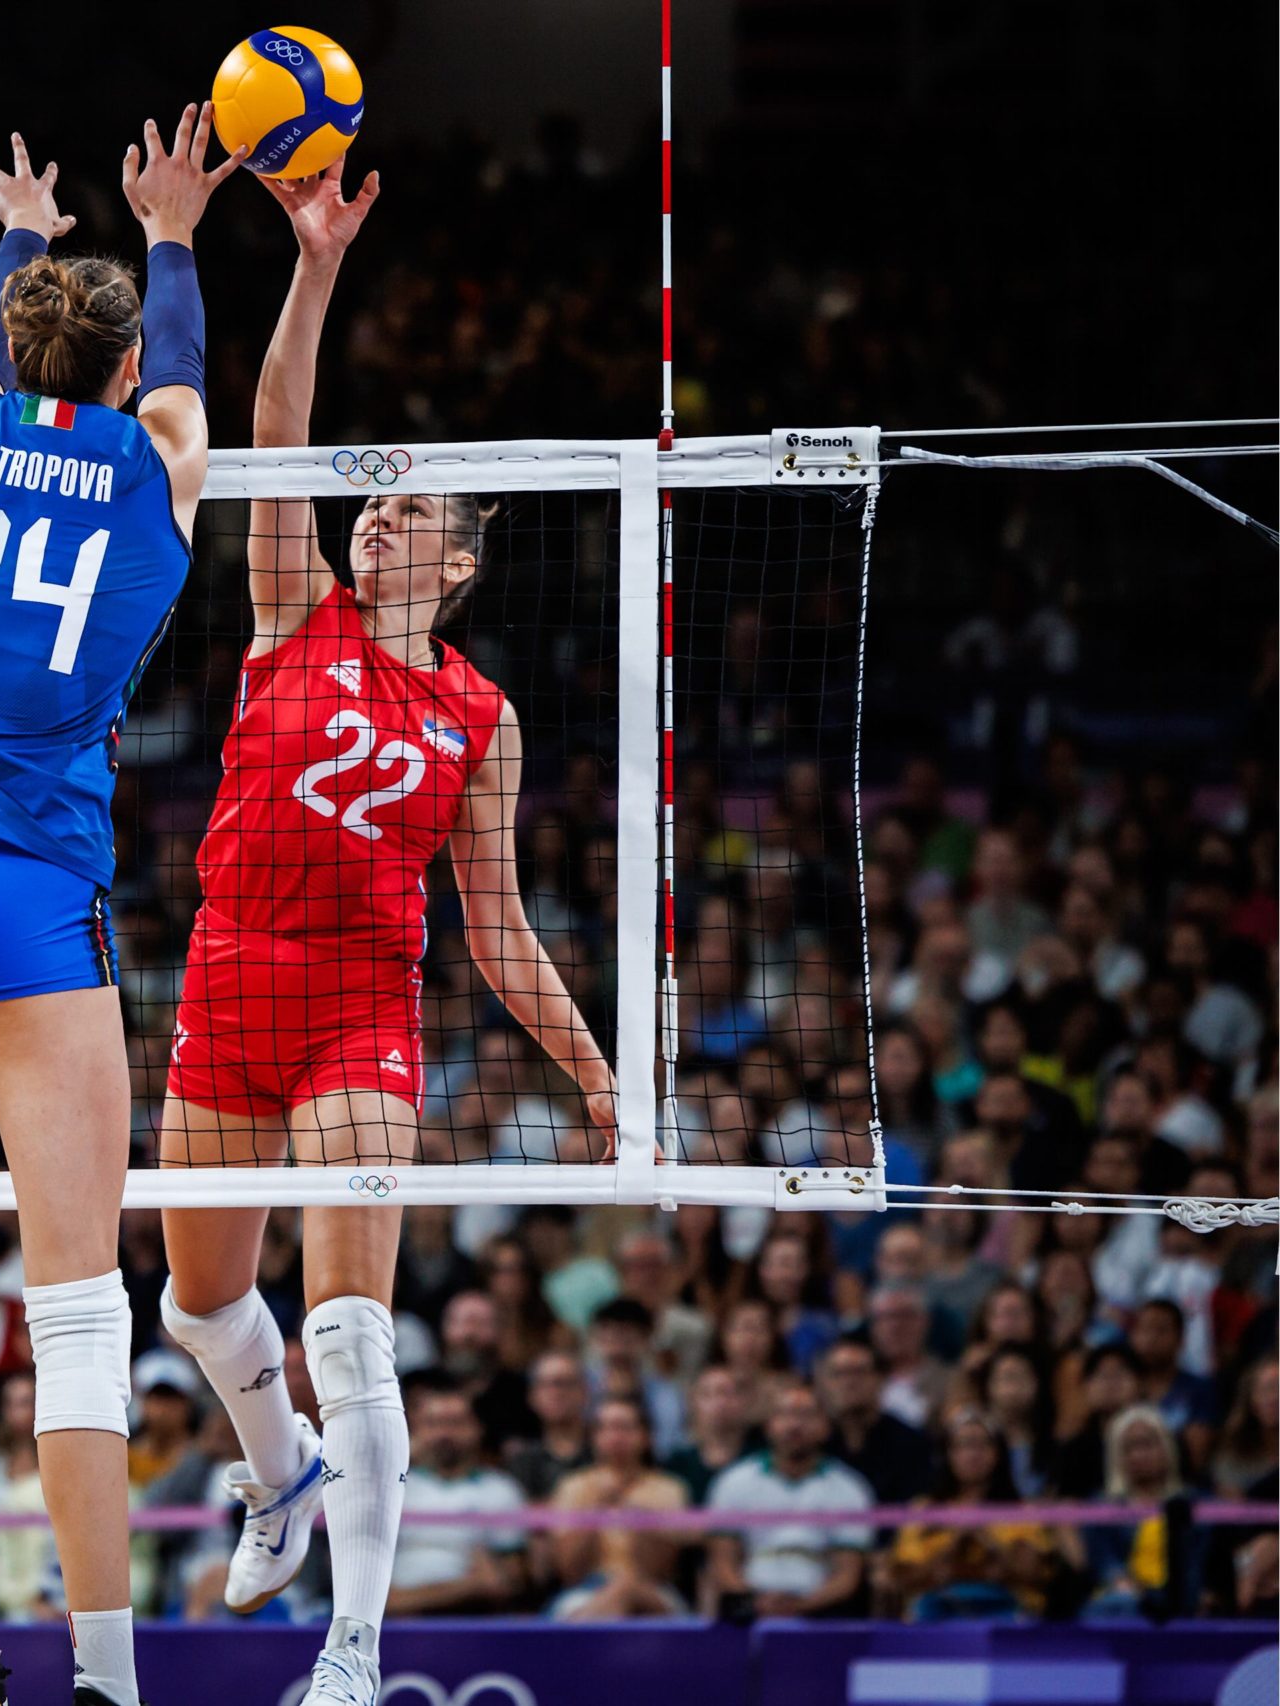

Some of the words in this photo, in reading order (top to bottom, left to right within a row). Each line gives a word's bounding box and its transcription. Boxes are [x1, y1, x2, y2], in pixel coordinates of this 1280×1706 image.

[268, 127, 301, 160] PARIS
[800, 435, 853, 447] Senoh
[292, 710, 426, 840] 22
